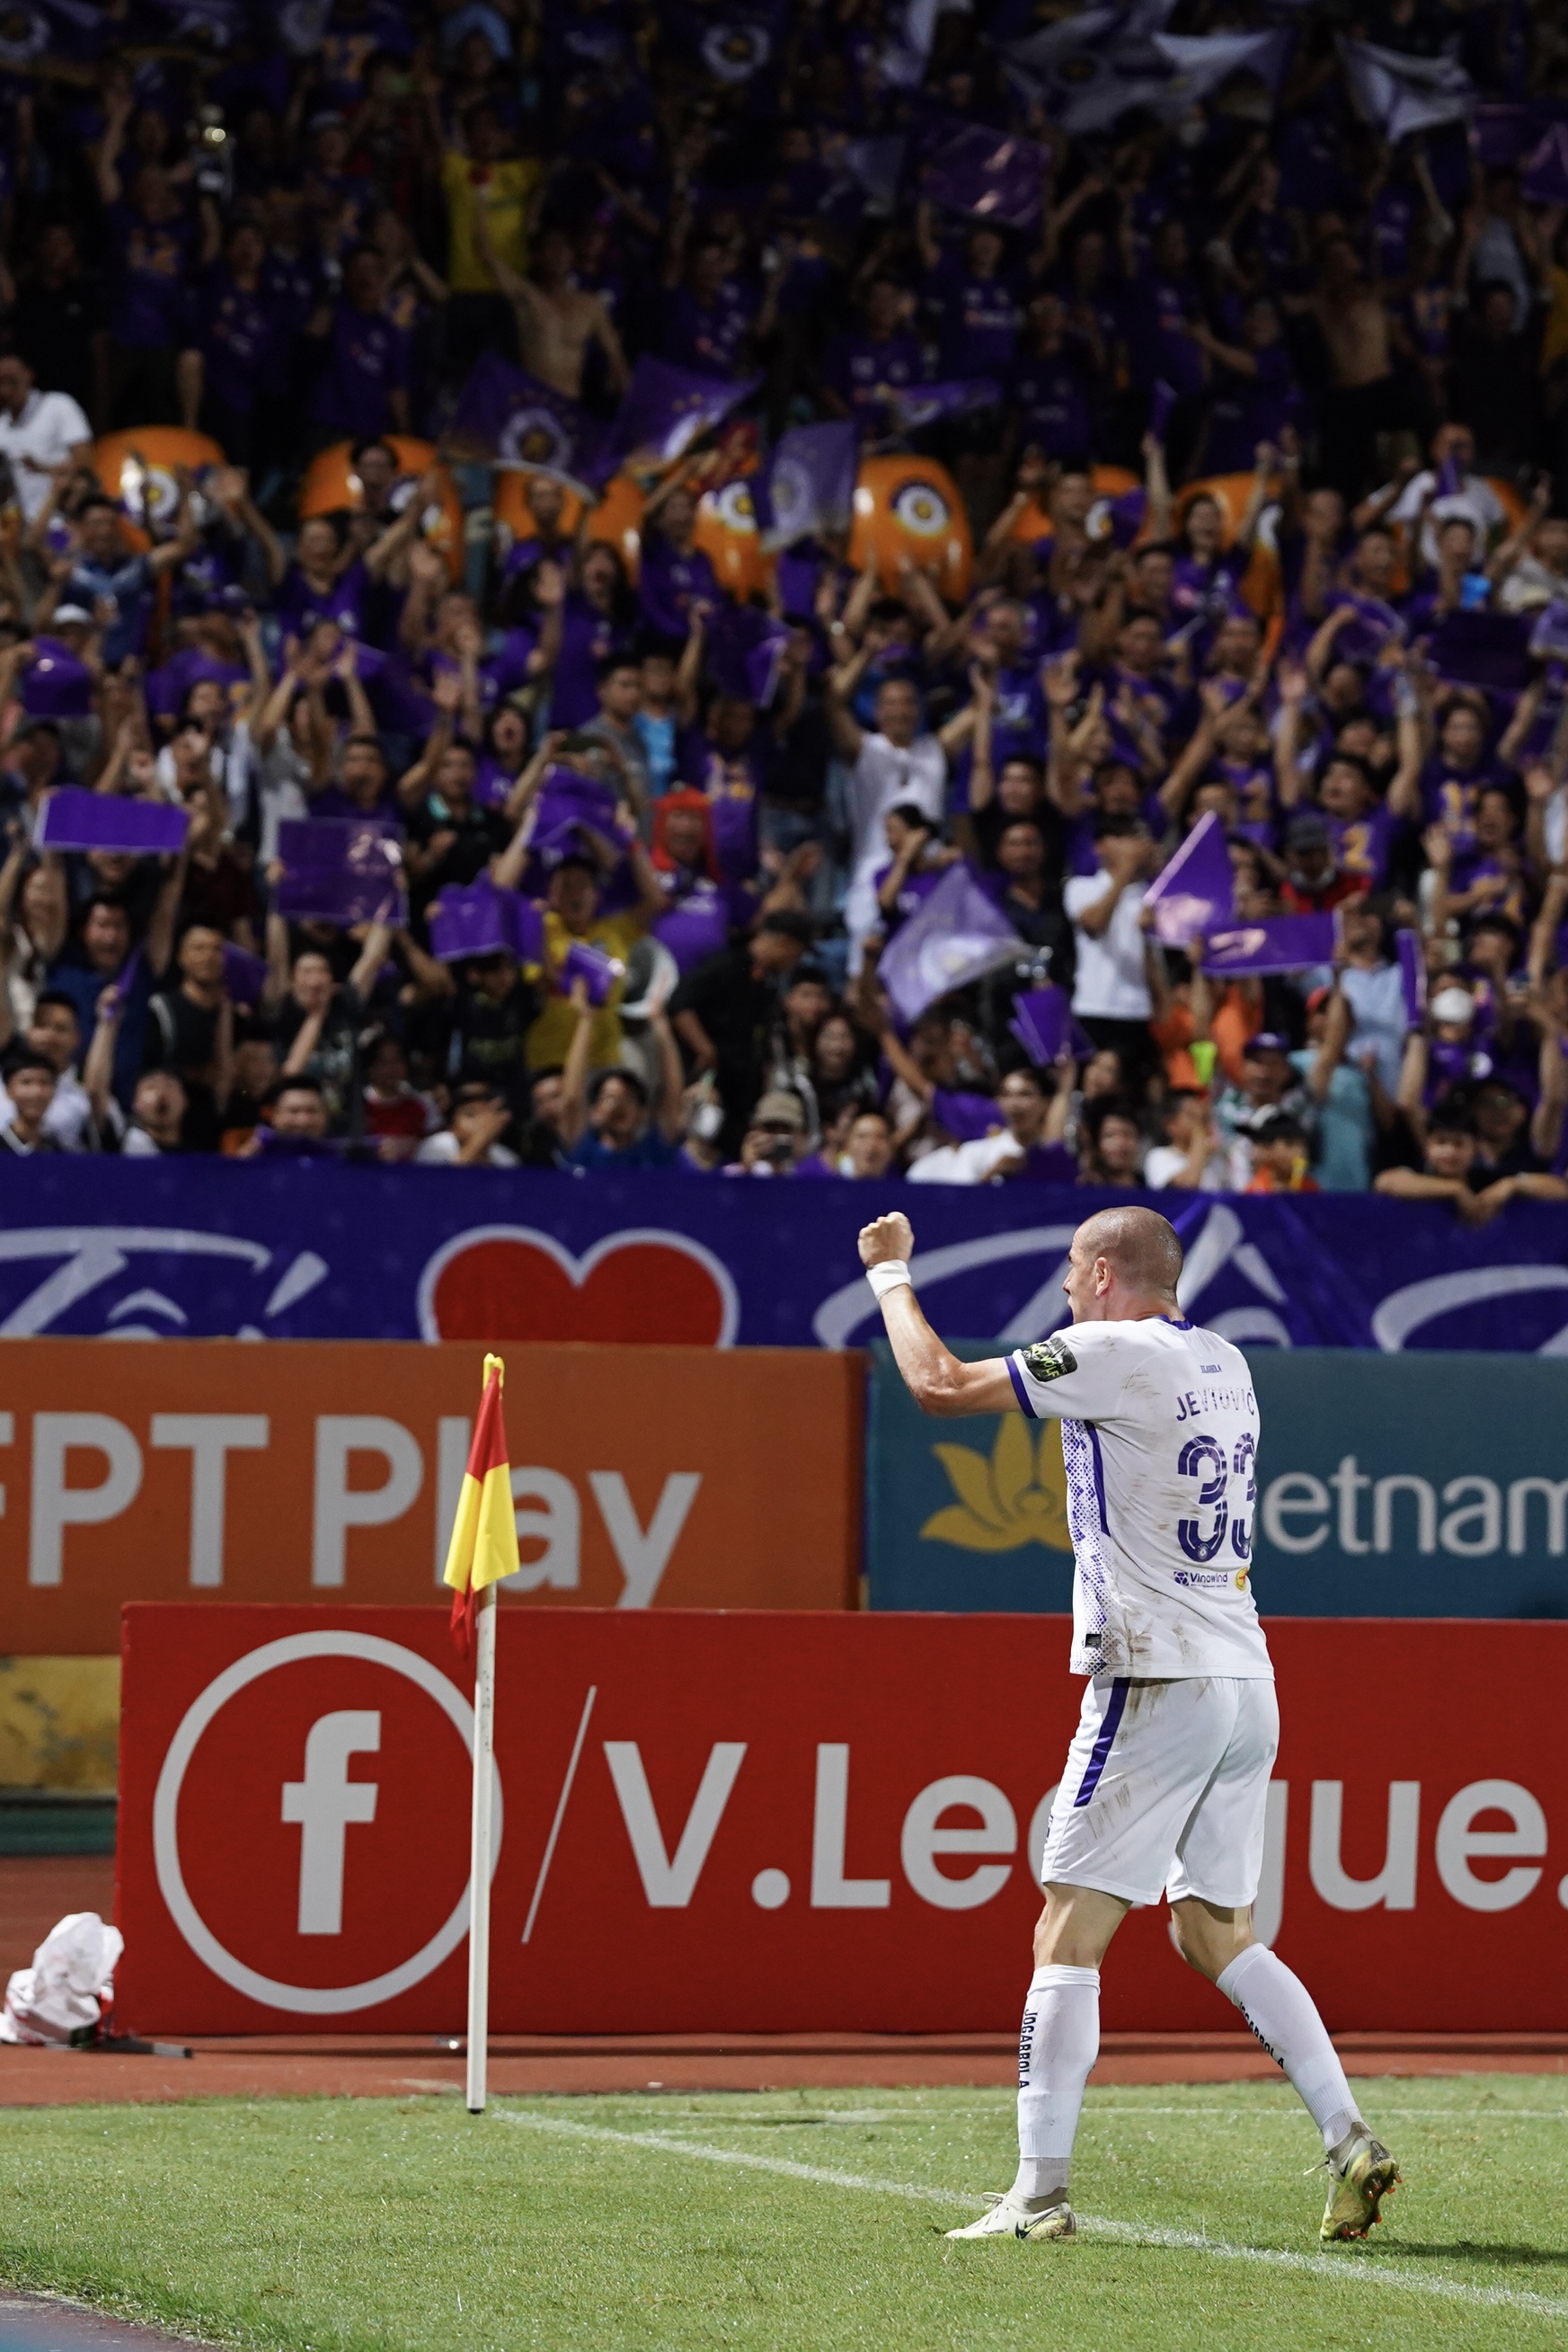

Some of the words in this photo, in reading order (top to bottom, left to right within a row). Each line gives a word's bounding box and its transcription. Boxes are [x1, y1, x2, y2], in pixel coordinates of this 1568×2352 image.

[0, 1411, 269, 1588] PT
[312, 1414, 703, 1609] Play
[1177, 1432, 1256, 1563] 33
[1250, 1454, 1568, 1557] etnam
